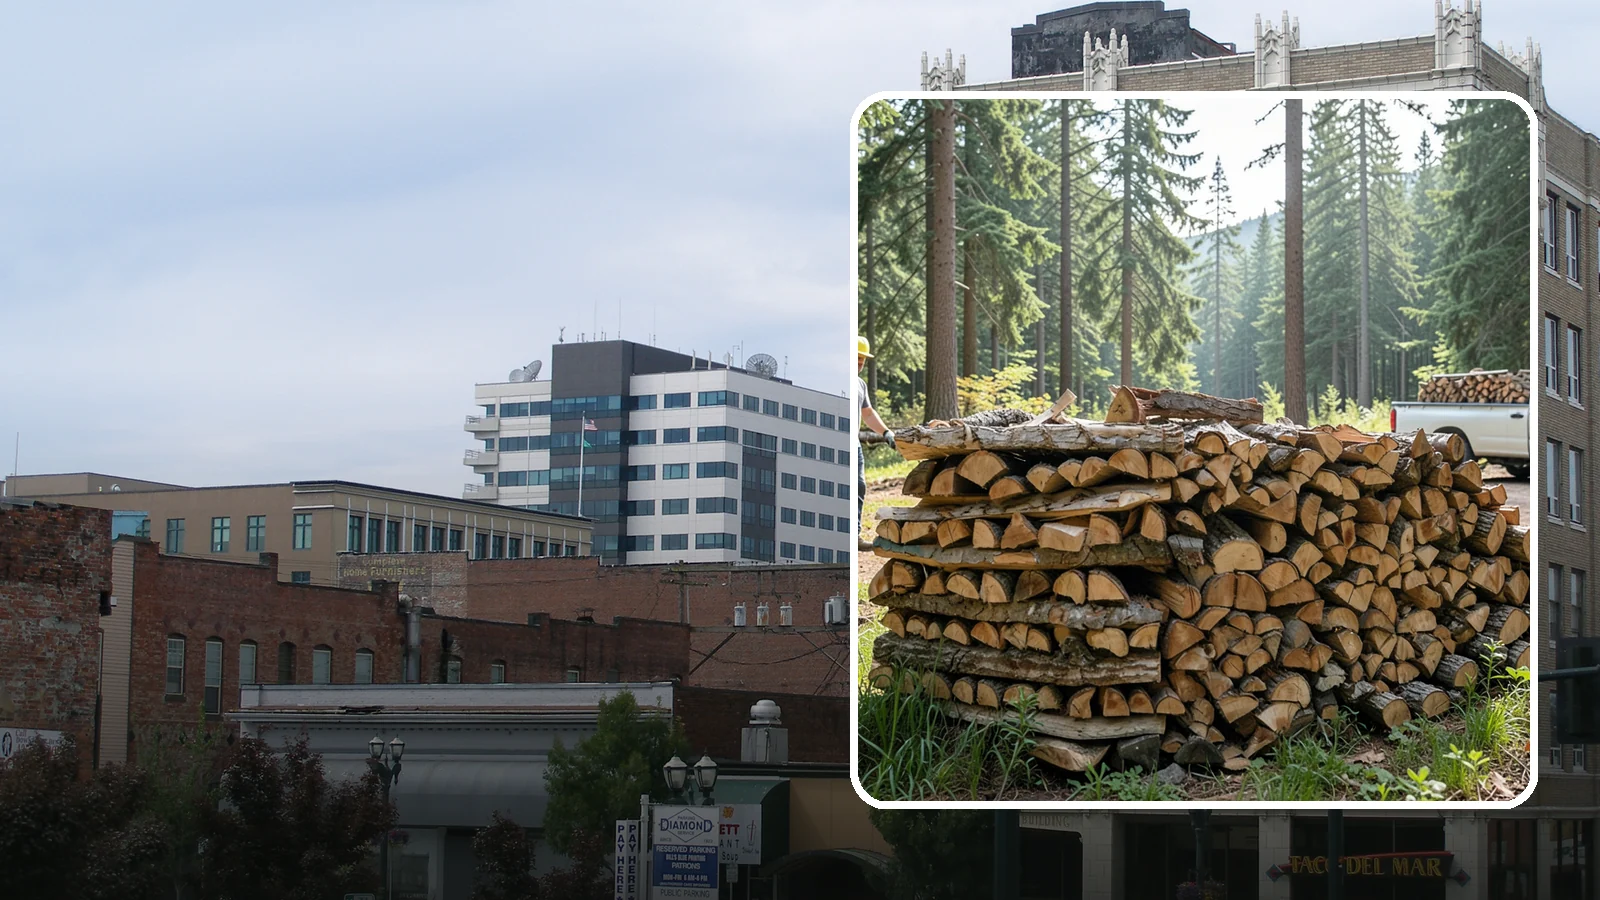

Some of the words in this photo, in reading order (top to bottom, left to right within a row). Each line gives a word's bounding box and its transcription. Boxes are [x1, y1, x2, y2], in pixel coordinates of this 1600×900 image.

[370, 566, 426, 576] Furnishers
[660, 818, 713, 832] DIAMOND
[1022, 815, 1070, 828] BUILDING
[617, 825, 625, 852] PAY
[628, 824, 636, 852] PAY
[656, 845, 688, 853] RESERVED
[689, 846, 716, 854] PARKING
[722, 851, 739, 862] Soup
[671, 862, 701, 870] PATRONS
[1346, 856, 1385, 876] DEL
[1392, 857, 1442, 877] MAR
[616, 856, 625, 893] HERE
[627, 855, 636, 893] HERE
[660, 888, 682, 897] PUBLIC
[684, 889, 710, 898] PARKING
